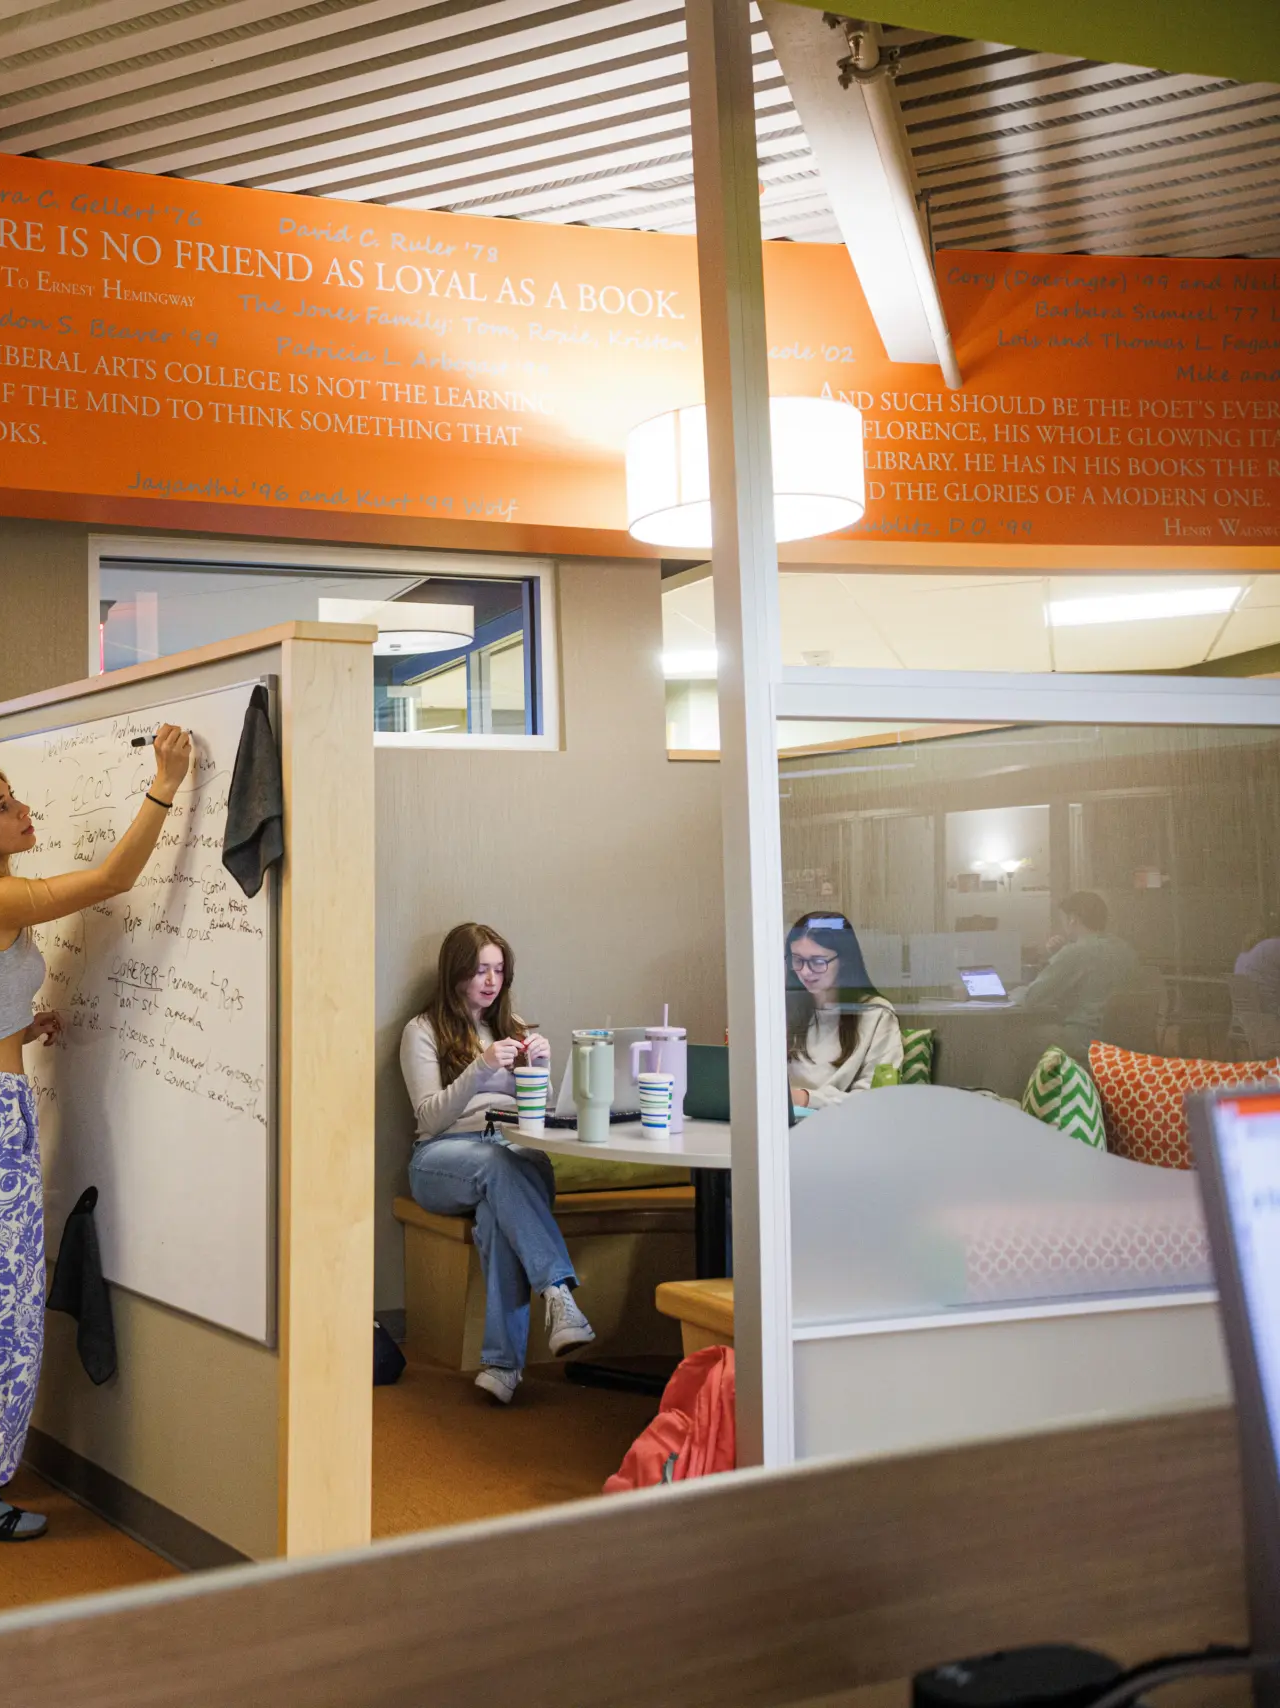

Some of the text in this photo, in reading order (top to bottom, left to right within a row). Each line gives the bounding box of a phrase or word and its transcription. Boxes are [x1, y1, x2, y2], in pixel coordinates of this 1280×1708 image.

[70, 192, 158, 223] Gellert
[278, 216, 353, 244] David
[391, 233, 457, 258] Ruler
[57, 225, 89, 258] IS
[99, 229, 162, 266] NO
[173, 239, 313, 283] FRIEND
[323, 257, 365, 289] AS
[376, 262, 488, 303] LOYAL
[495, 277, 536, 307] AS
[545, 281, 569, 311] A
[577, 283, 686, 320] BOOK.
[1179, 272, 1224, 291] and
[1035, 300, 1126, 320] Barbara
[1132, 301, 1218, 322] Samuel
[90, 318, 173, 344] Beaver
[239, 292, 285, 316] The
[293, 299, 360, 325] Jones
[768, 340, 816, 361] cole
[276, 336, 376, 364] Patricia
[997, 330, 1040, 349] Lois
[1048, 331, 1092, 349] and
[1100, 332, 1189, 352] Thomas
[93, 354, 157, 381] ARTS
[164, 361, 282, 393] COLLEGE
[288, 373, 309, 395] IS
[316, 375, 371, 401] NOT
[377, 381, 428, 406] THE
[435, 387, 555, 415] LEARNING
[1176, 363, 1231, 383] Mike
[21, 384, 78, 410] THE
[85, 390, 161, 418] MIND
[167, 397, 203, 421] TO
[209, 402, 294, 430] THINK
[300, 410, 452, 443] SOMETHING
[457, 422, 522, 447] THAT
[880, 391, 943, 414] SUCH
[949, 392, 1045, 416] SHOULD
[1052, 396, 1081, 417] BE
[1084, 397, 1132, 418] THE
[1138, 398, 1215, 419] POET'S
[863, 420, 987, 444] FLORENCE,
[993, 423, 1031, 443] HIS
[1036, 425, 1121, 446] WHOLE
[1127, 427, 1241, 448] GLOWING
[865, 450, 958, 472] LIBRARY.
[964, 453, 996, 473] HE
[1003, 454, 1046, 474] HAS
[1052, 455, 1077, 475] IN
[1084, 456, 1121, 476] HIS
[1127, 457, 1206, 477] BOOKS
[1210, 458, 1260, 477] THE
[299, 484, 350, 507] and
[356, 488, 412, 512] Kurt
[463, 496, 518, 523] Wolf
[891, 481, 939, 502] THE
[944, 482, 1040, 504] GLORIES
[1045, 485, 1076, 505] OF
[1082, 486, 1096, 505] A
[1102, 486, 1207, 507] MODERN
[1213, 487, 1271, 508] ONE.
